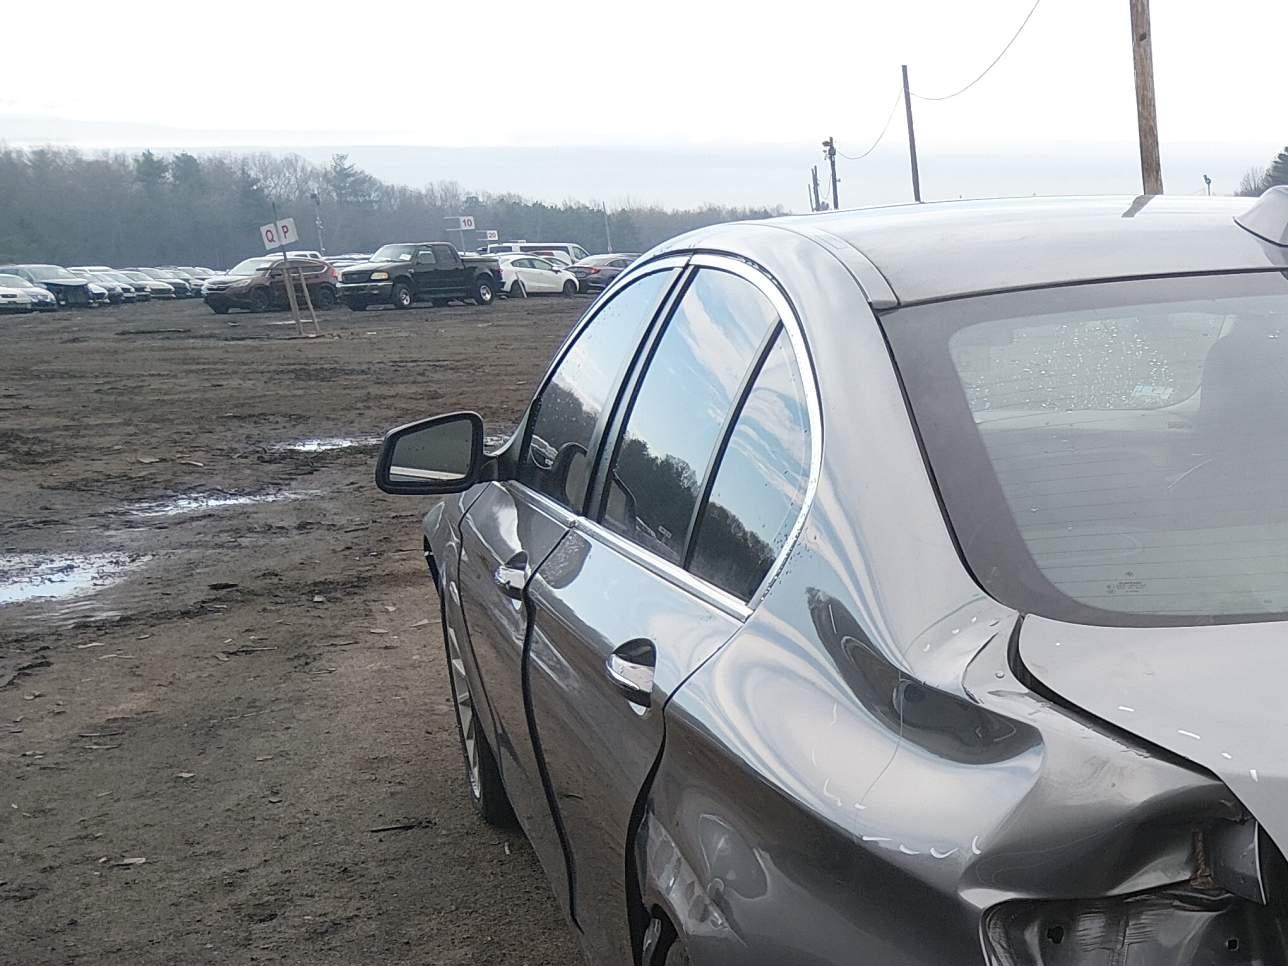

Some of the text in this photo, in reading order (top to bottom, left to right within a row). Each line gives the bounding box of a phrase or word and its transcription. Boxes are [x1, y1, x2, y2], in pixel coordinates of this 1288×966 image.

[461, 218, 473, 228] 10
[264, 229, 277, 244] Q
[281, 224, 289, 240] P
[487, 231, 497, 239] 20
